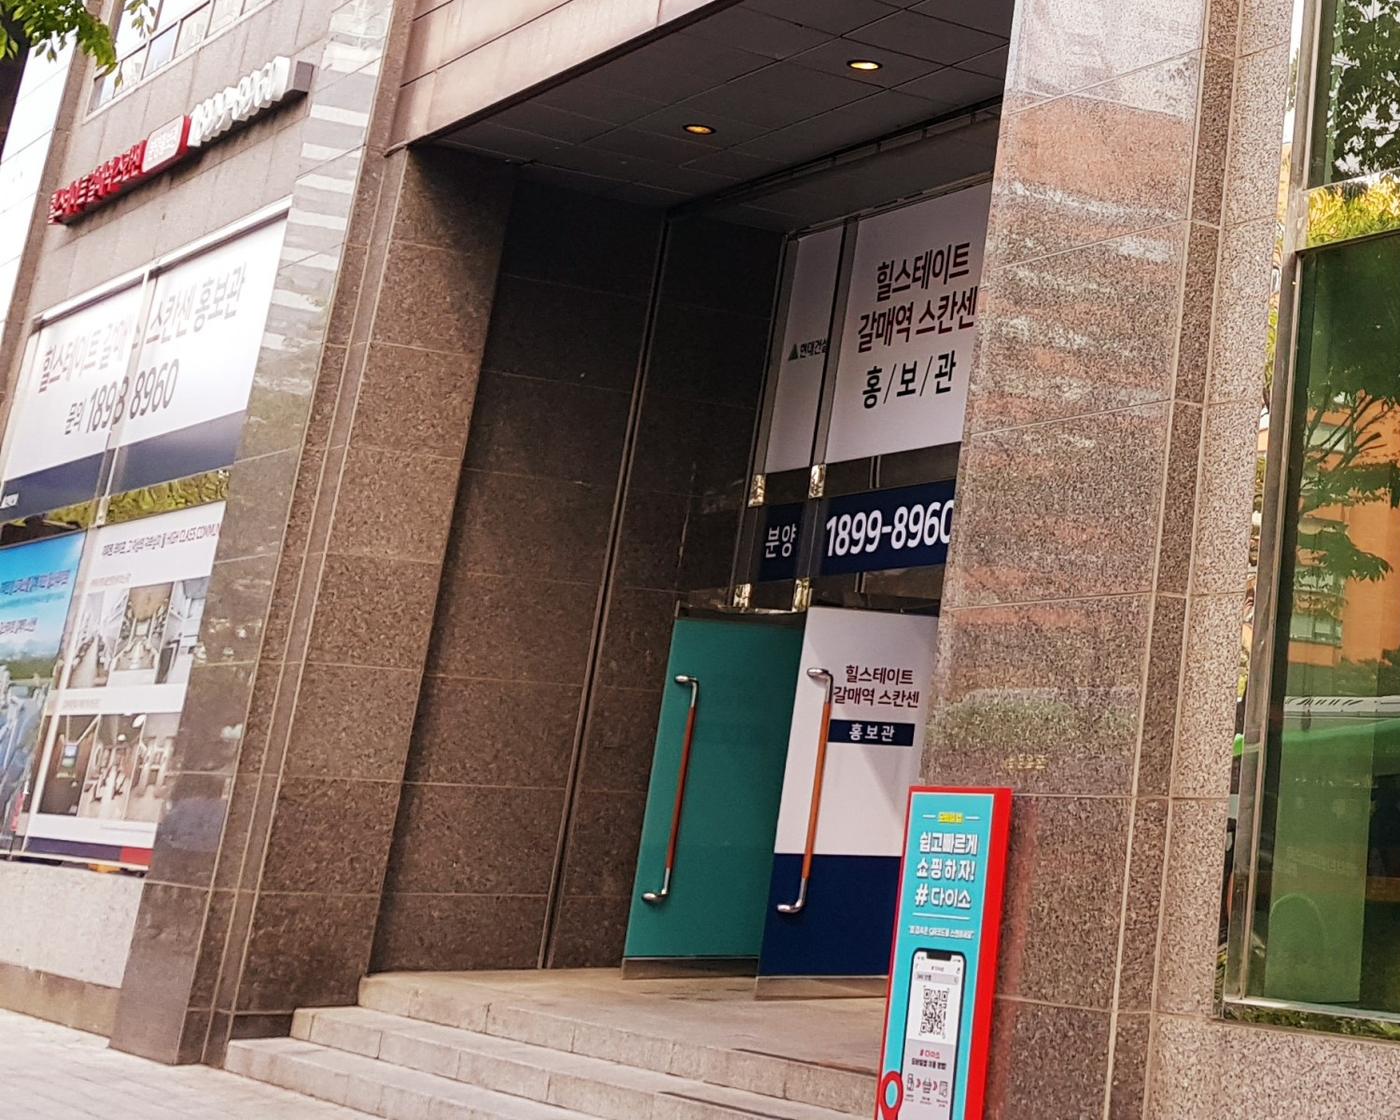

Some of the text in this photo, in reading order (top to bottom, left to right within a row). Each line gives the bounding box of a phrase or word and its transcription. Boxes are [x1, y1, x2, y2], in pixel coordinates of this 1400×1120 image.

[876, 242, 971, 303] 힐스테이트
[857, 285, 979, 354] 갈매역 스칸센
[765, 522, 797, 559] 분양
[845, 664, 913, 686] 힐스테이트
[833, 686, 920, 709] 갈매역 스칸센
[919, 831, 978, 856] 쉽고빠르게
